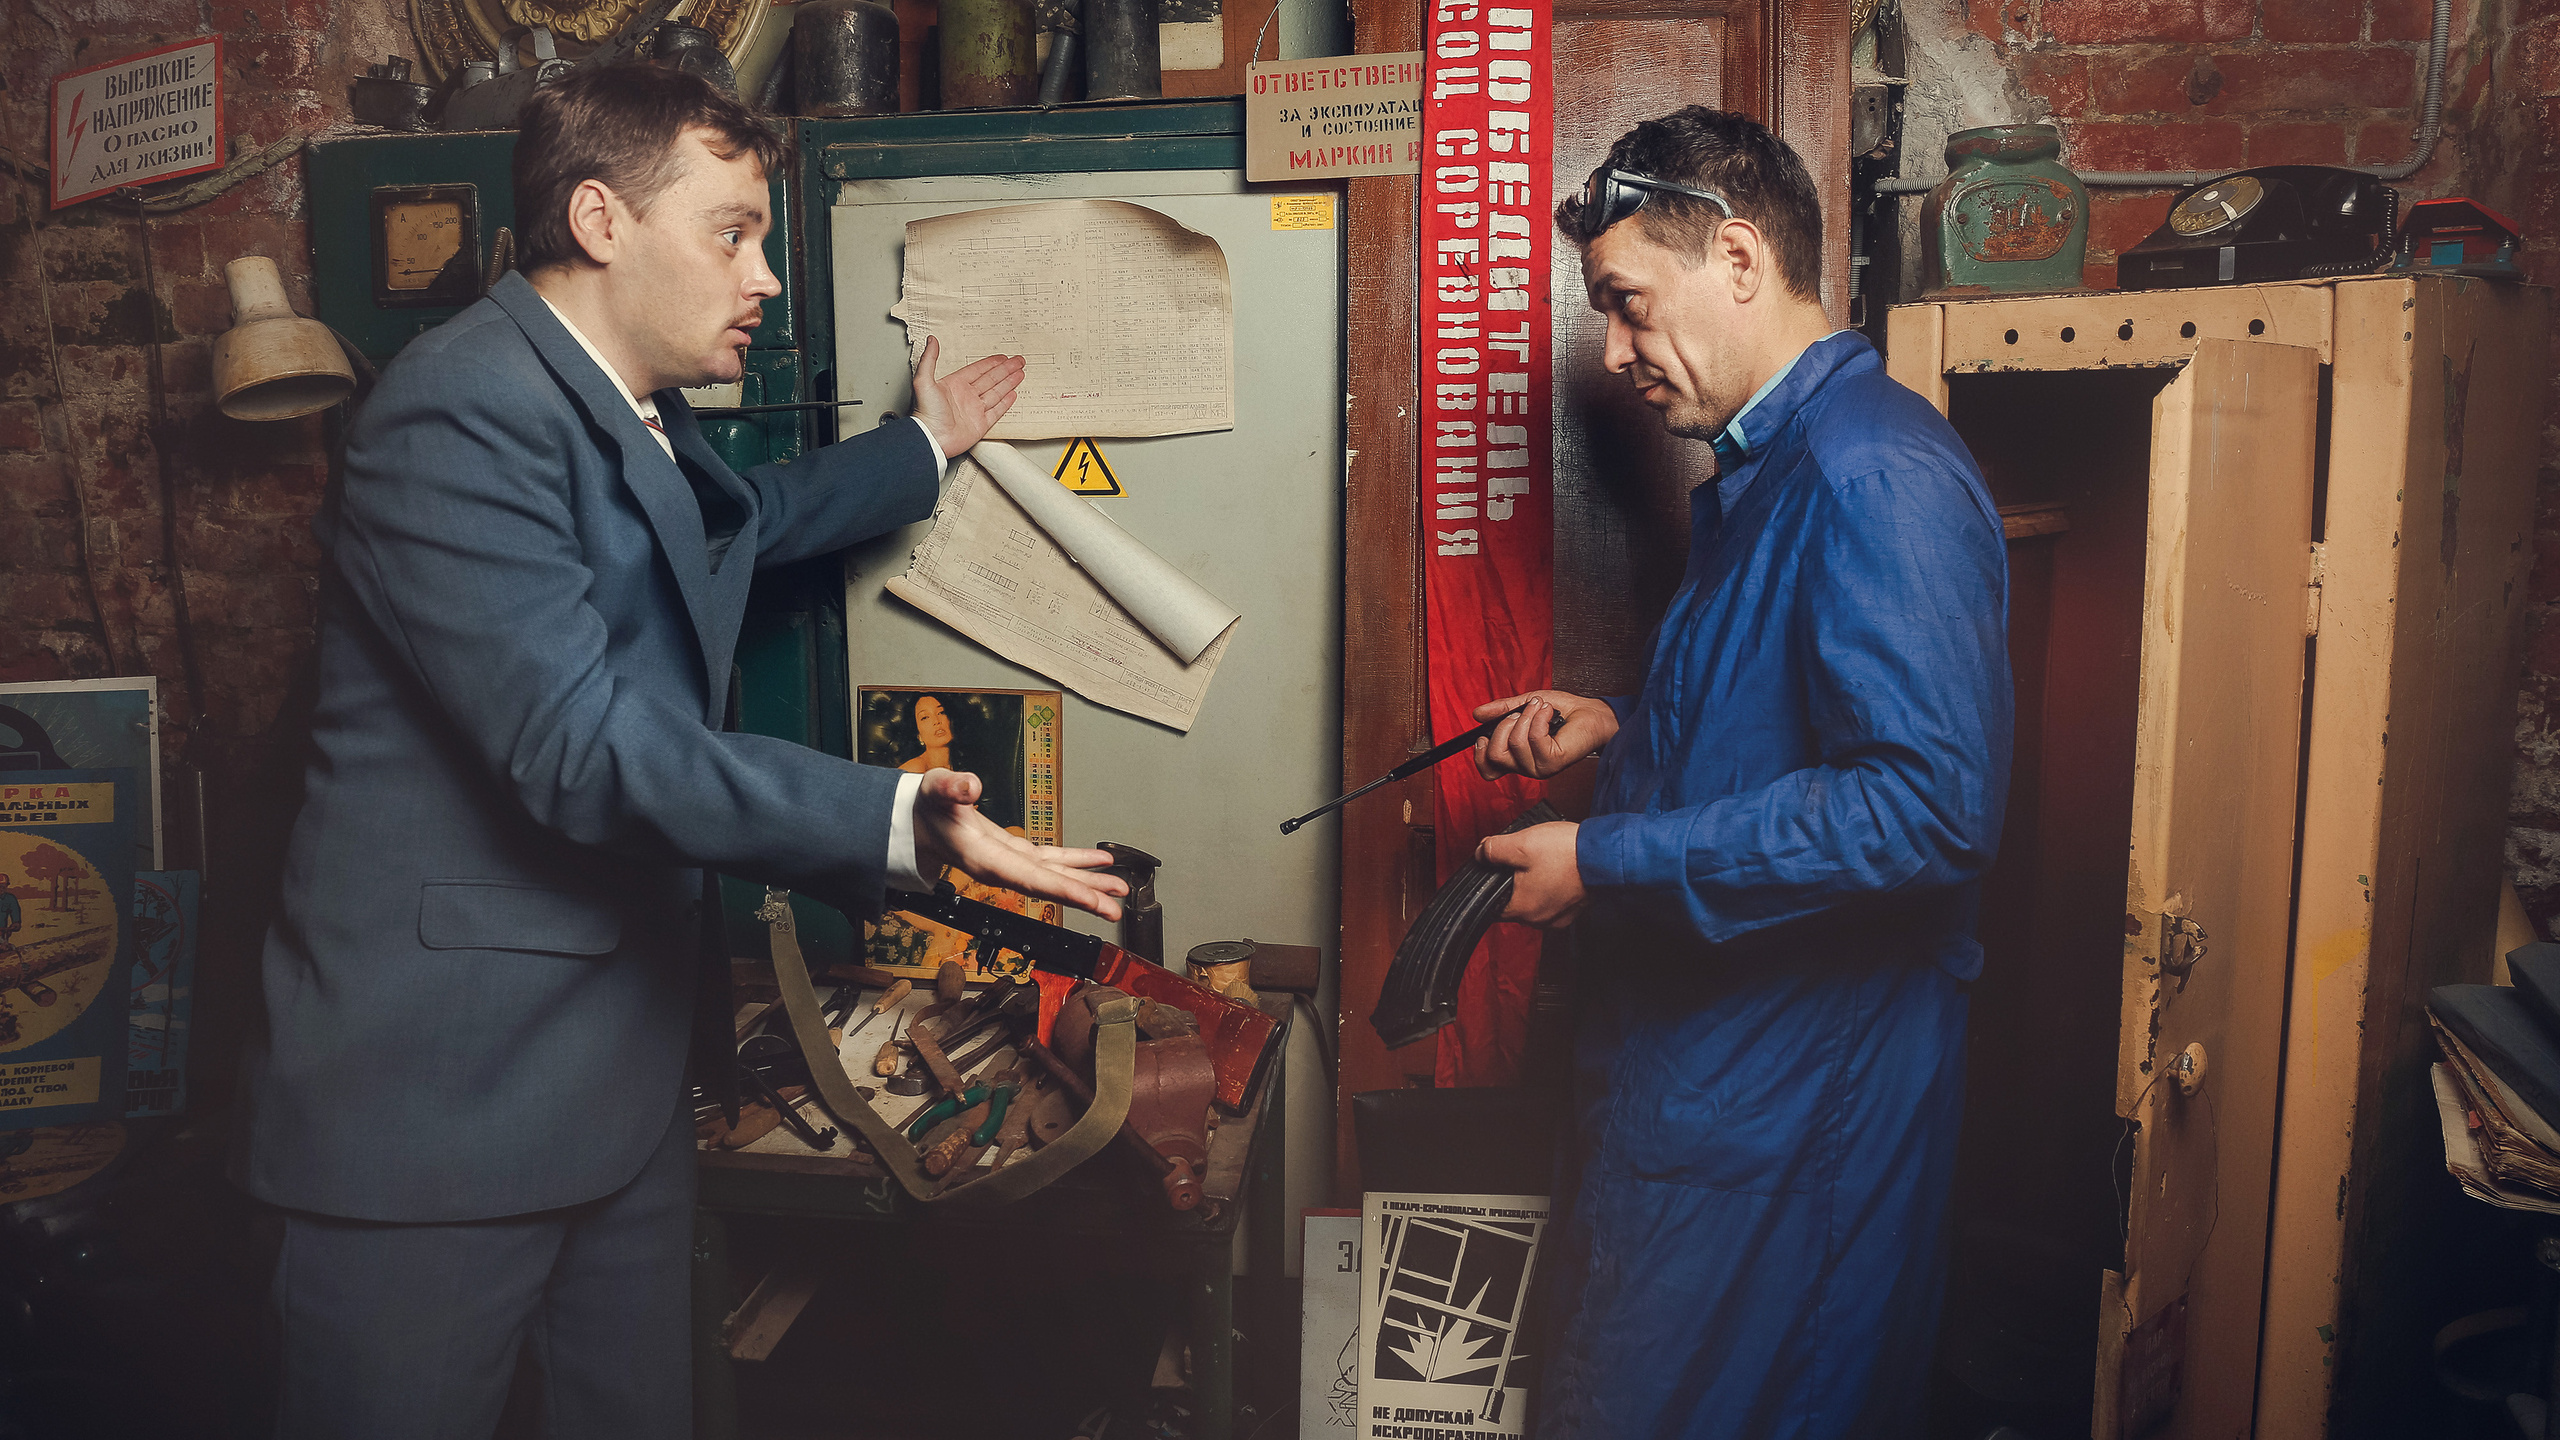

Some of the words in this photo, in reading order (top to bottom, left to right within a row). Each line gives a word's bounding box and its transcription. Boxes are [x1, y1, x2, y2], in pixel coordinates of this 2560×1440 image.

[93, 82, 213, 134] НАПРЯЖЕНИЕ
[1279, 108, 1301, 123] ЗА
[1301, 124, 1311, 138] И
[1323, 116, 1416, 136] СОСТОЯНИЕ
[90, 158, 128, 184] ДЛЯ
[136, 134, 213, 170] ЖИЗНИ!
[1289, 143, 1393, 170] МАРКИН
[1487, 8, 1533, 521] ПОБЕДИТЕЛЬ
[1436, 128, 1480, 556] СОРЕВНОВАНИЯ
[14, 1060, 75, 1076] КОРНЕВОЙ
[1, 1087, 26, 1097] ПОД
[33, 1084, 68, 1094] СТВОЛ
[1373, 1406, 1391, 1420] НЕ
[1394, 1408, 1475, 1426] ДОПУСКАЙ
